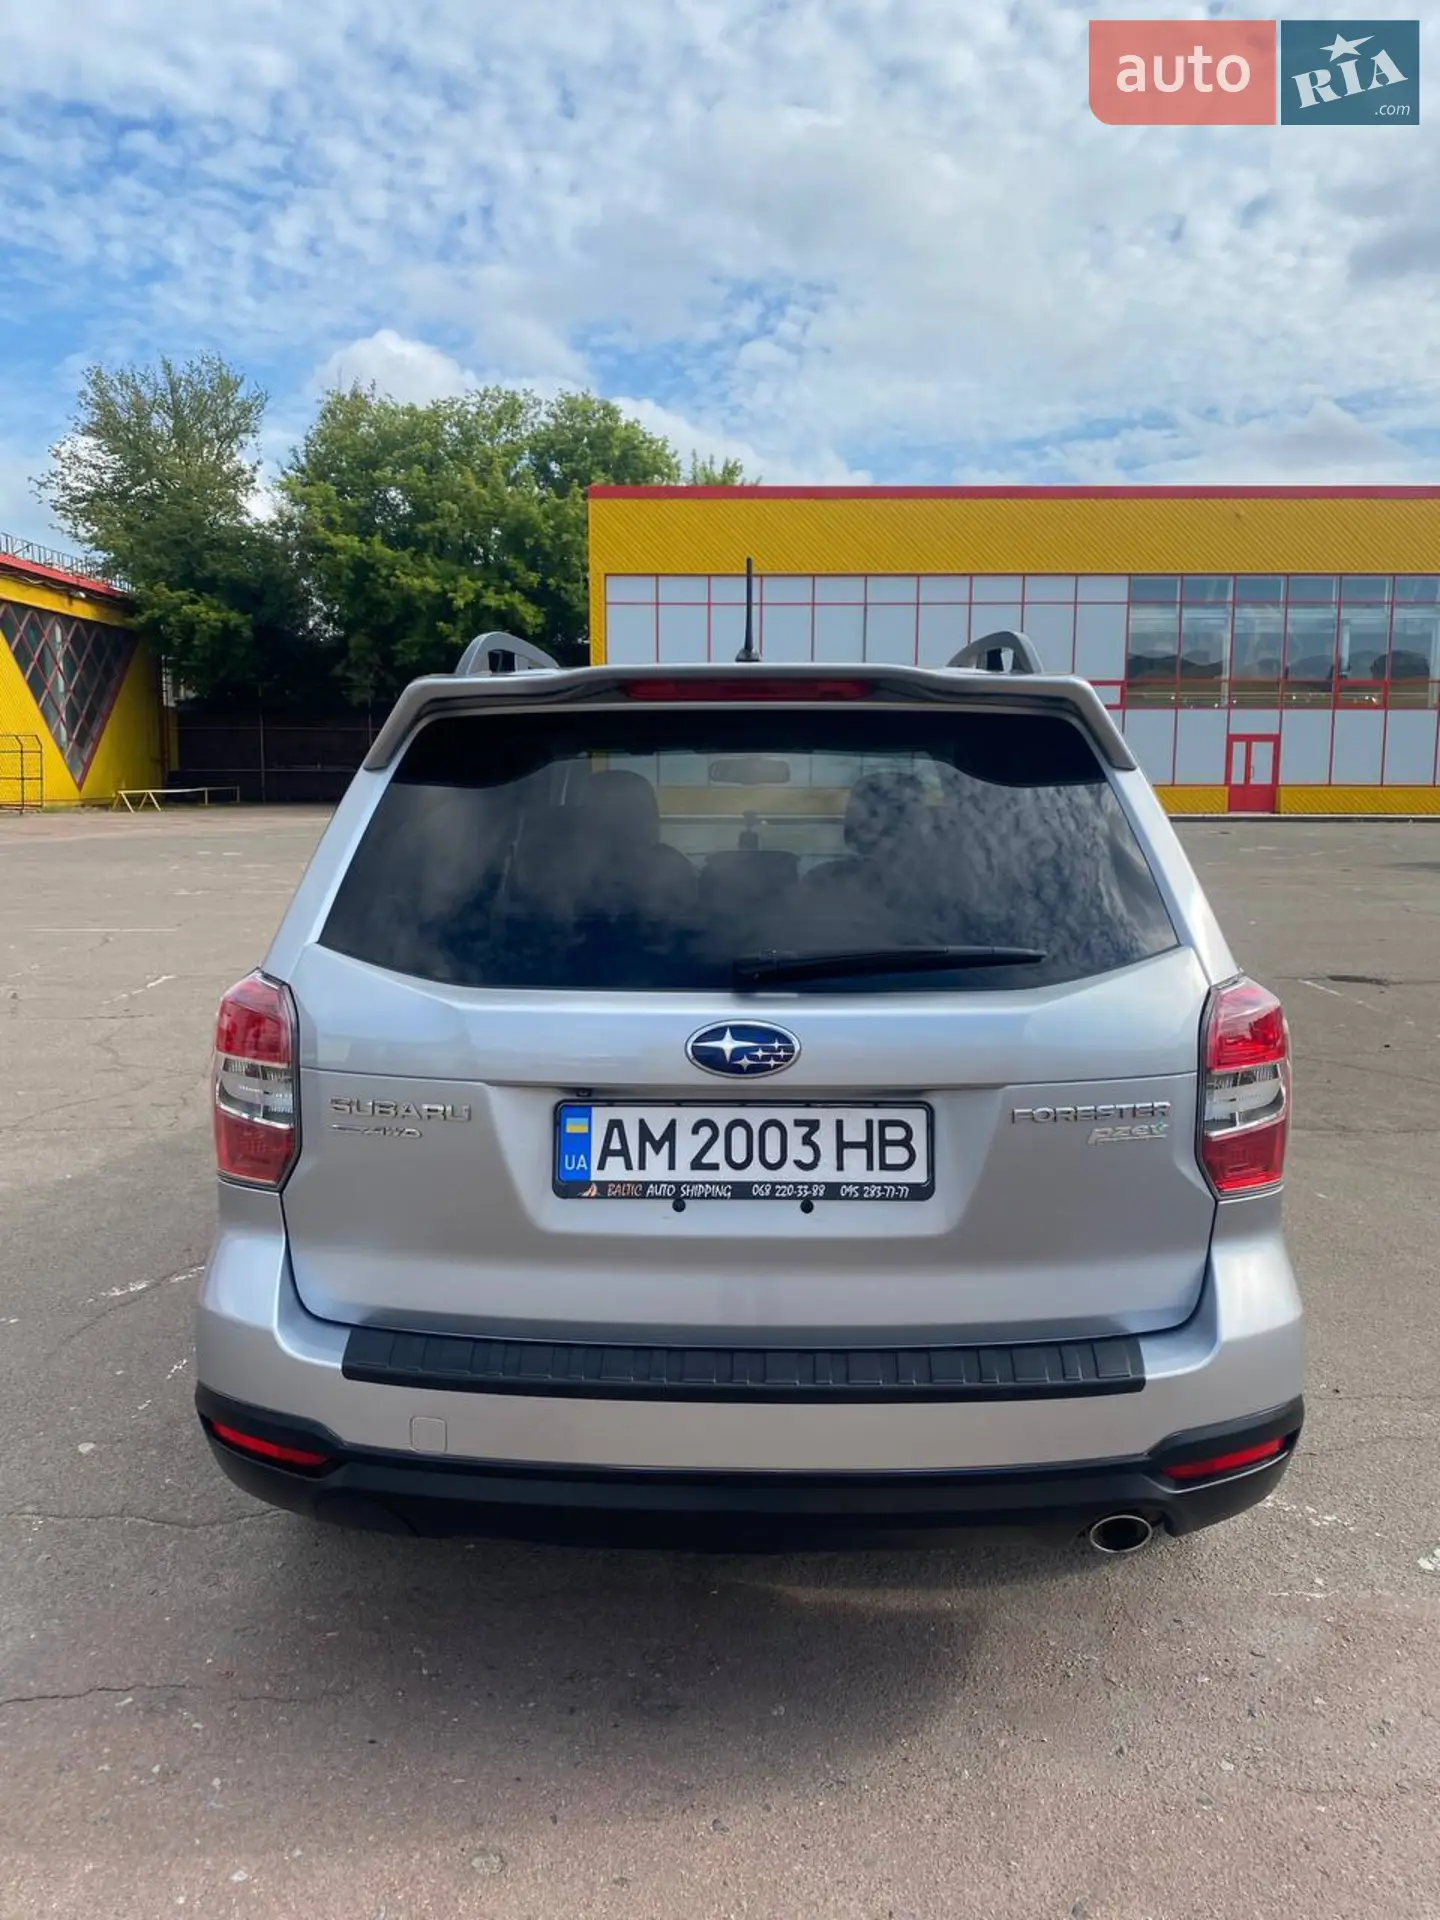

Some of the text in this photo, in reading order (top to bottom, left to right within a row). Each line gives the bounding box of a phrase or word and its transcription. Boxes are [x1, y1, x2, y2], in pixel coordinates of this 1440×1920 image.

[330, 1096, 472, 1122] SUBARU
[1011, 1101, 1171, 1124] FORESTER
[597, 1118, 917, 1171] AM 2003 HB
[564, 1153, 588, 1171] UA
[607, 1183, 732, 1199] BALTIC AUTO SHIPPING
[752, 1184, 826, 1197] 068 220-33-88
[840, 1184, 860, 1198] 095
